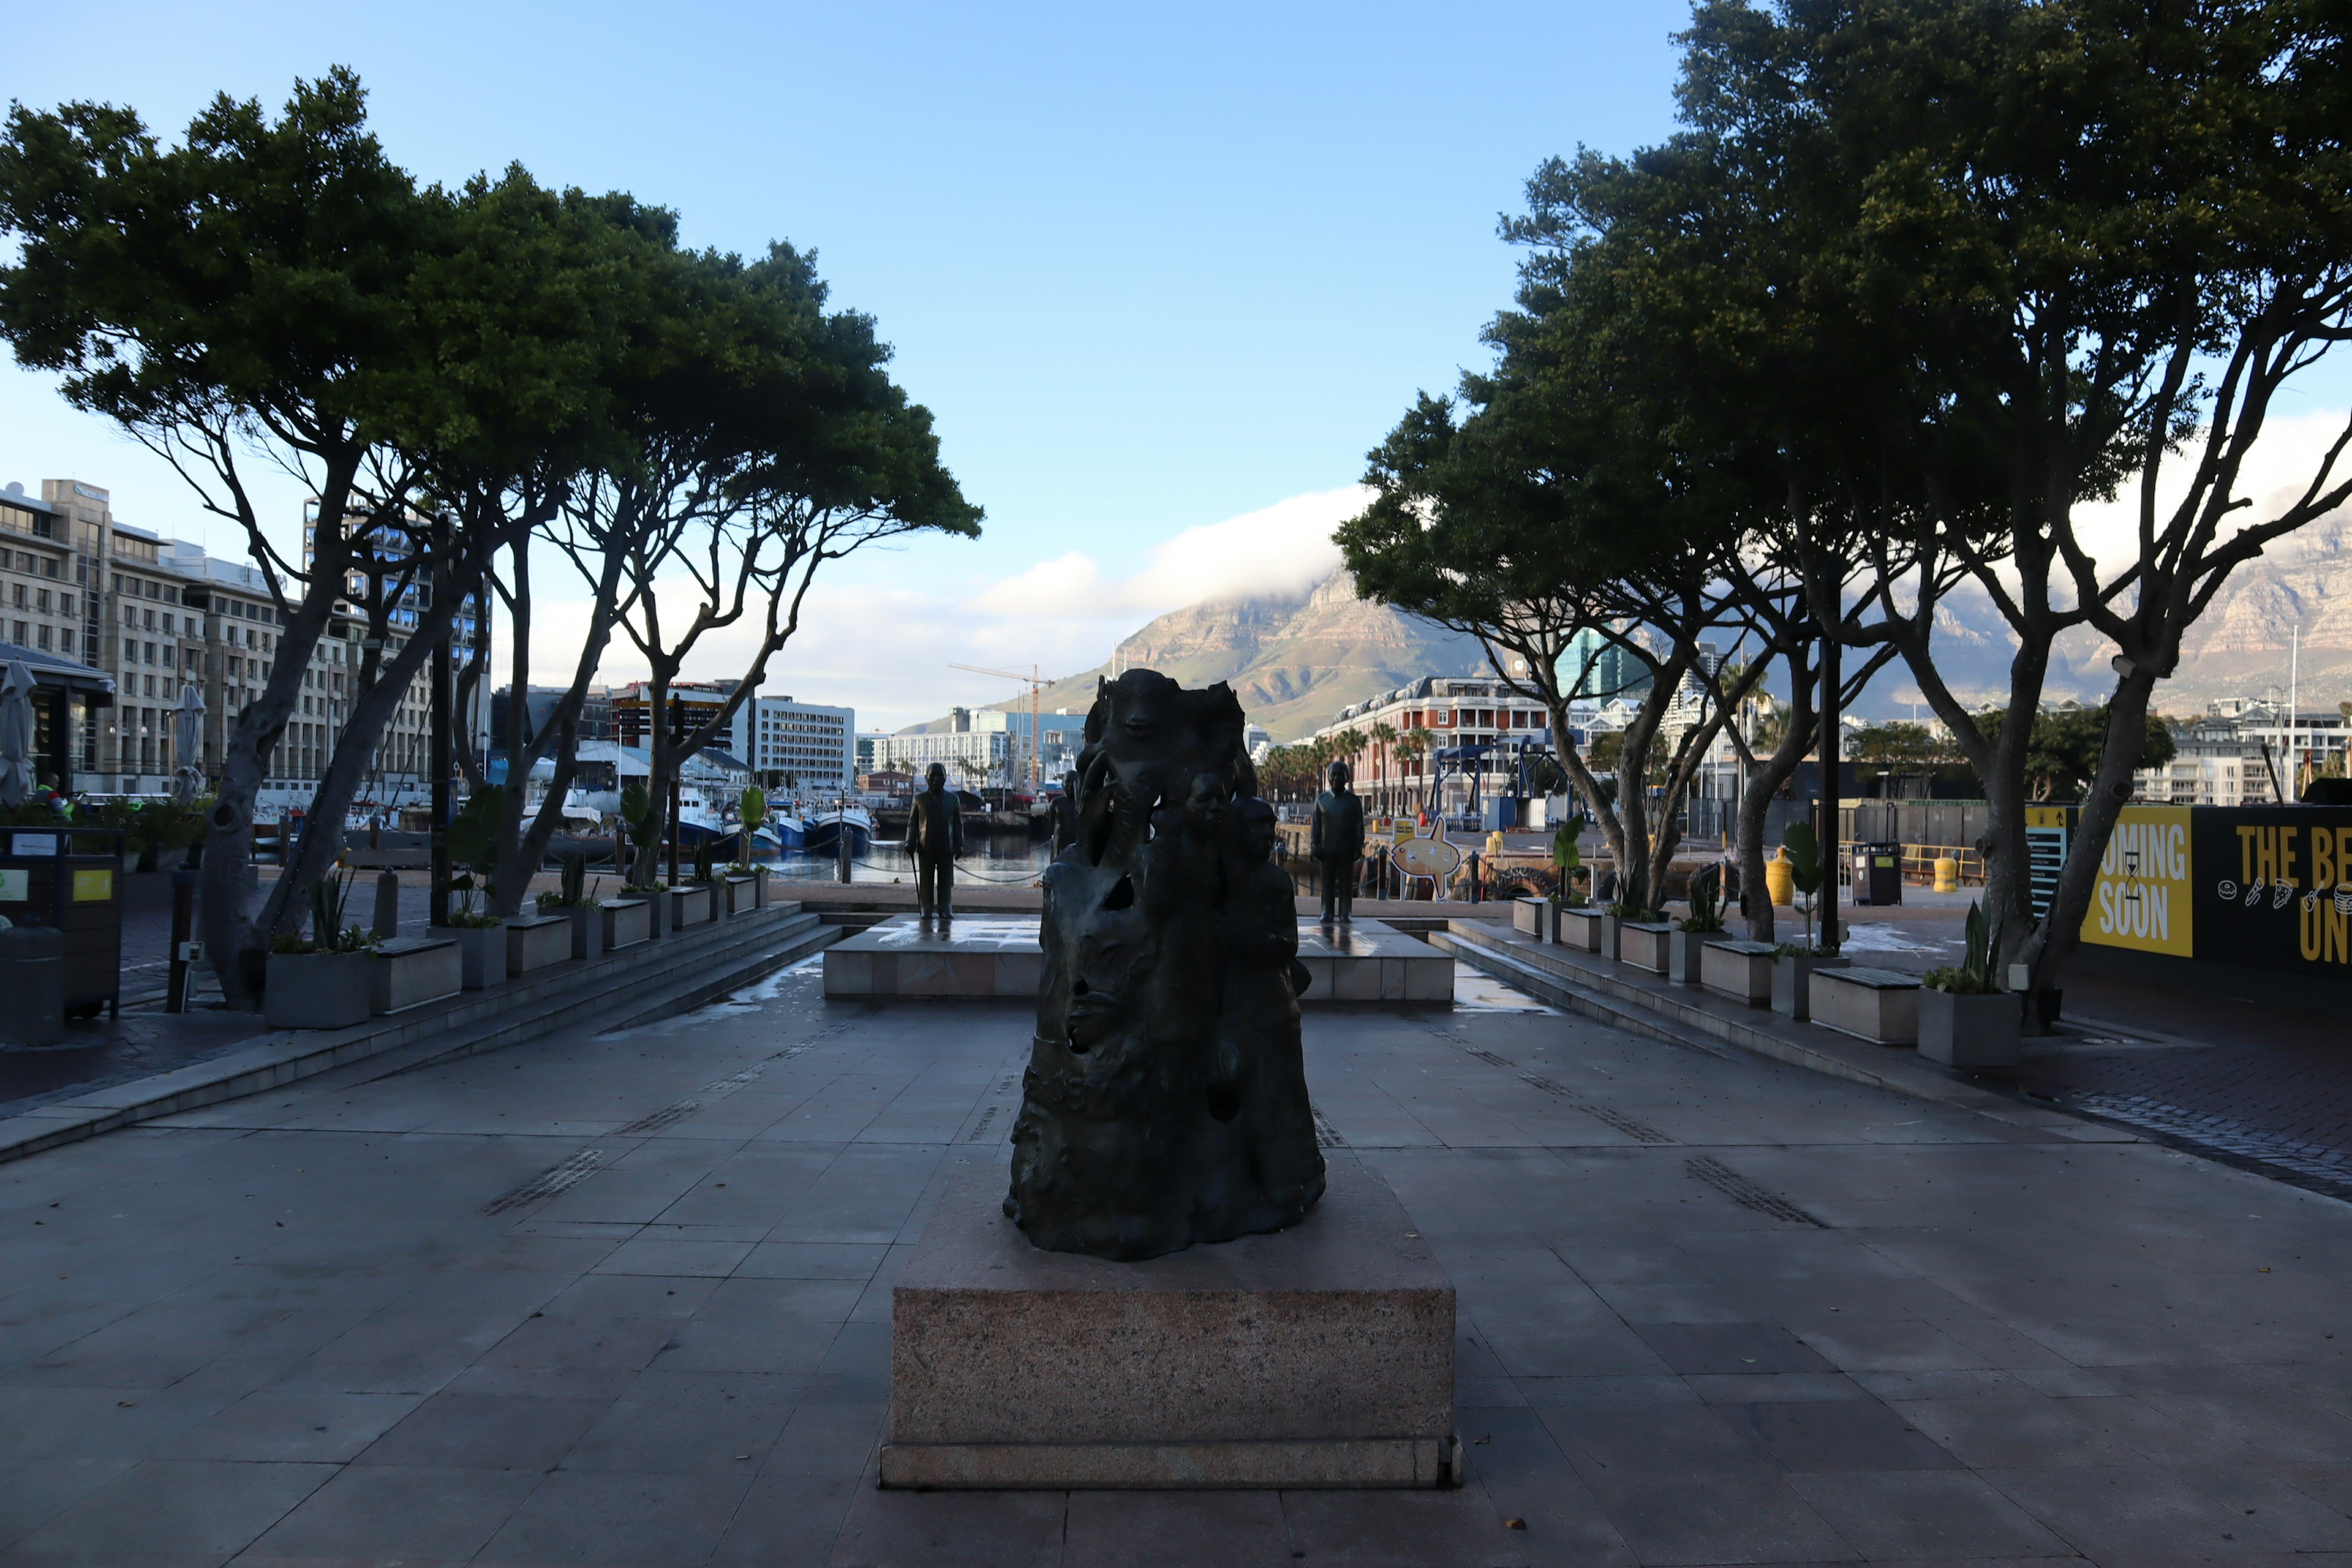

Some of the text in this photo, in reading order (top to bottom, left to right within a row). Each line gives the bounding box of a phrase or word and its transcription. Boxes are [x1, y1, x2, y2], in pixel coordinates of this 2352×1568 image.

[2101, 823, 2185, 880] OMING
[2236, 826, 2299, 888] THE
[2099, 881, 2168, 940] SOON
[2300, 897, 2352, 964] UN
